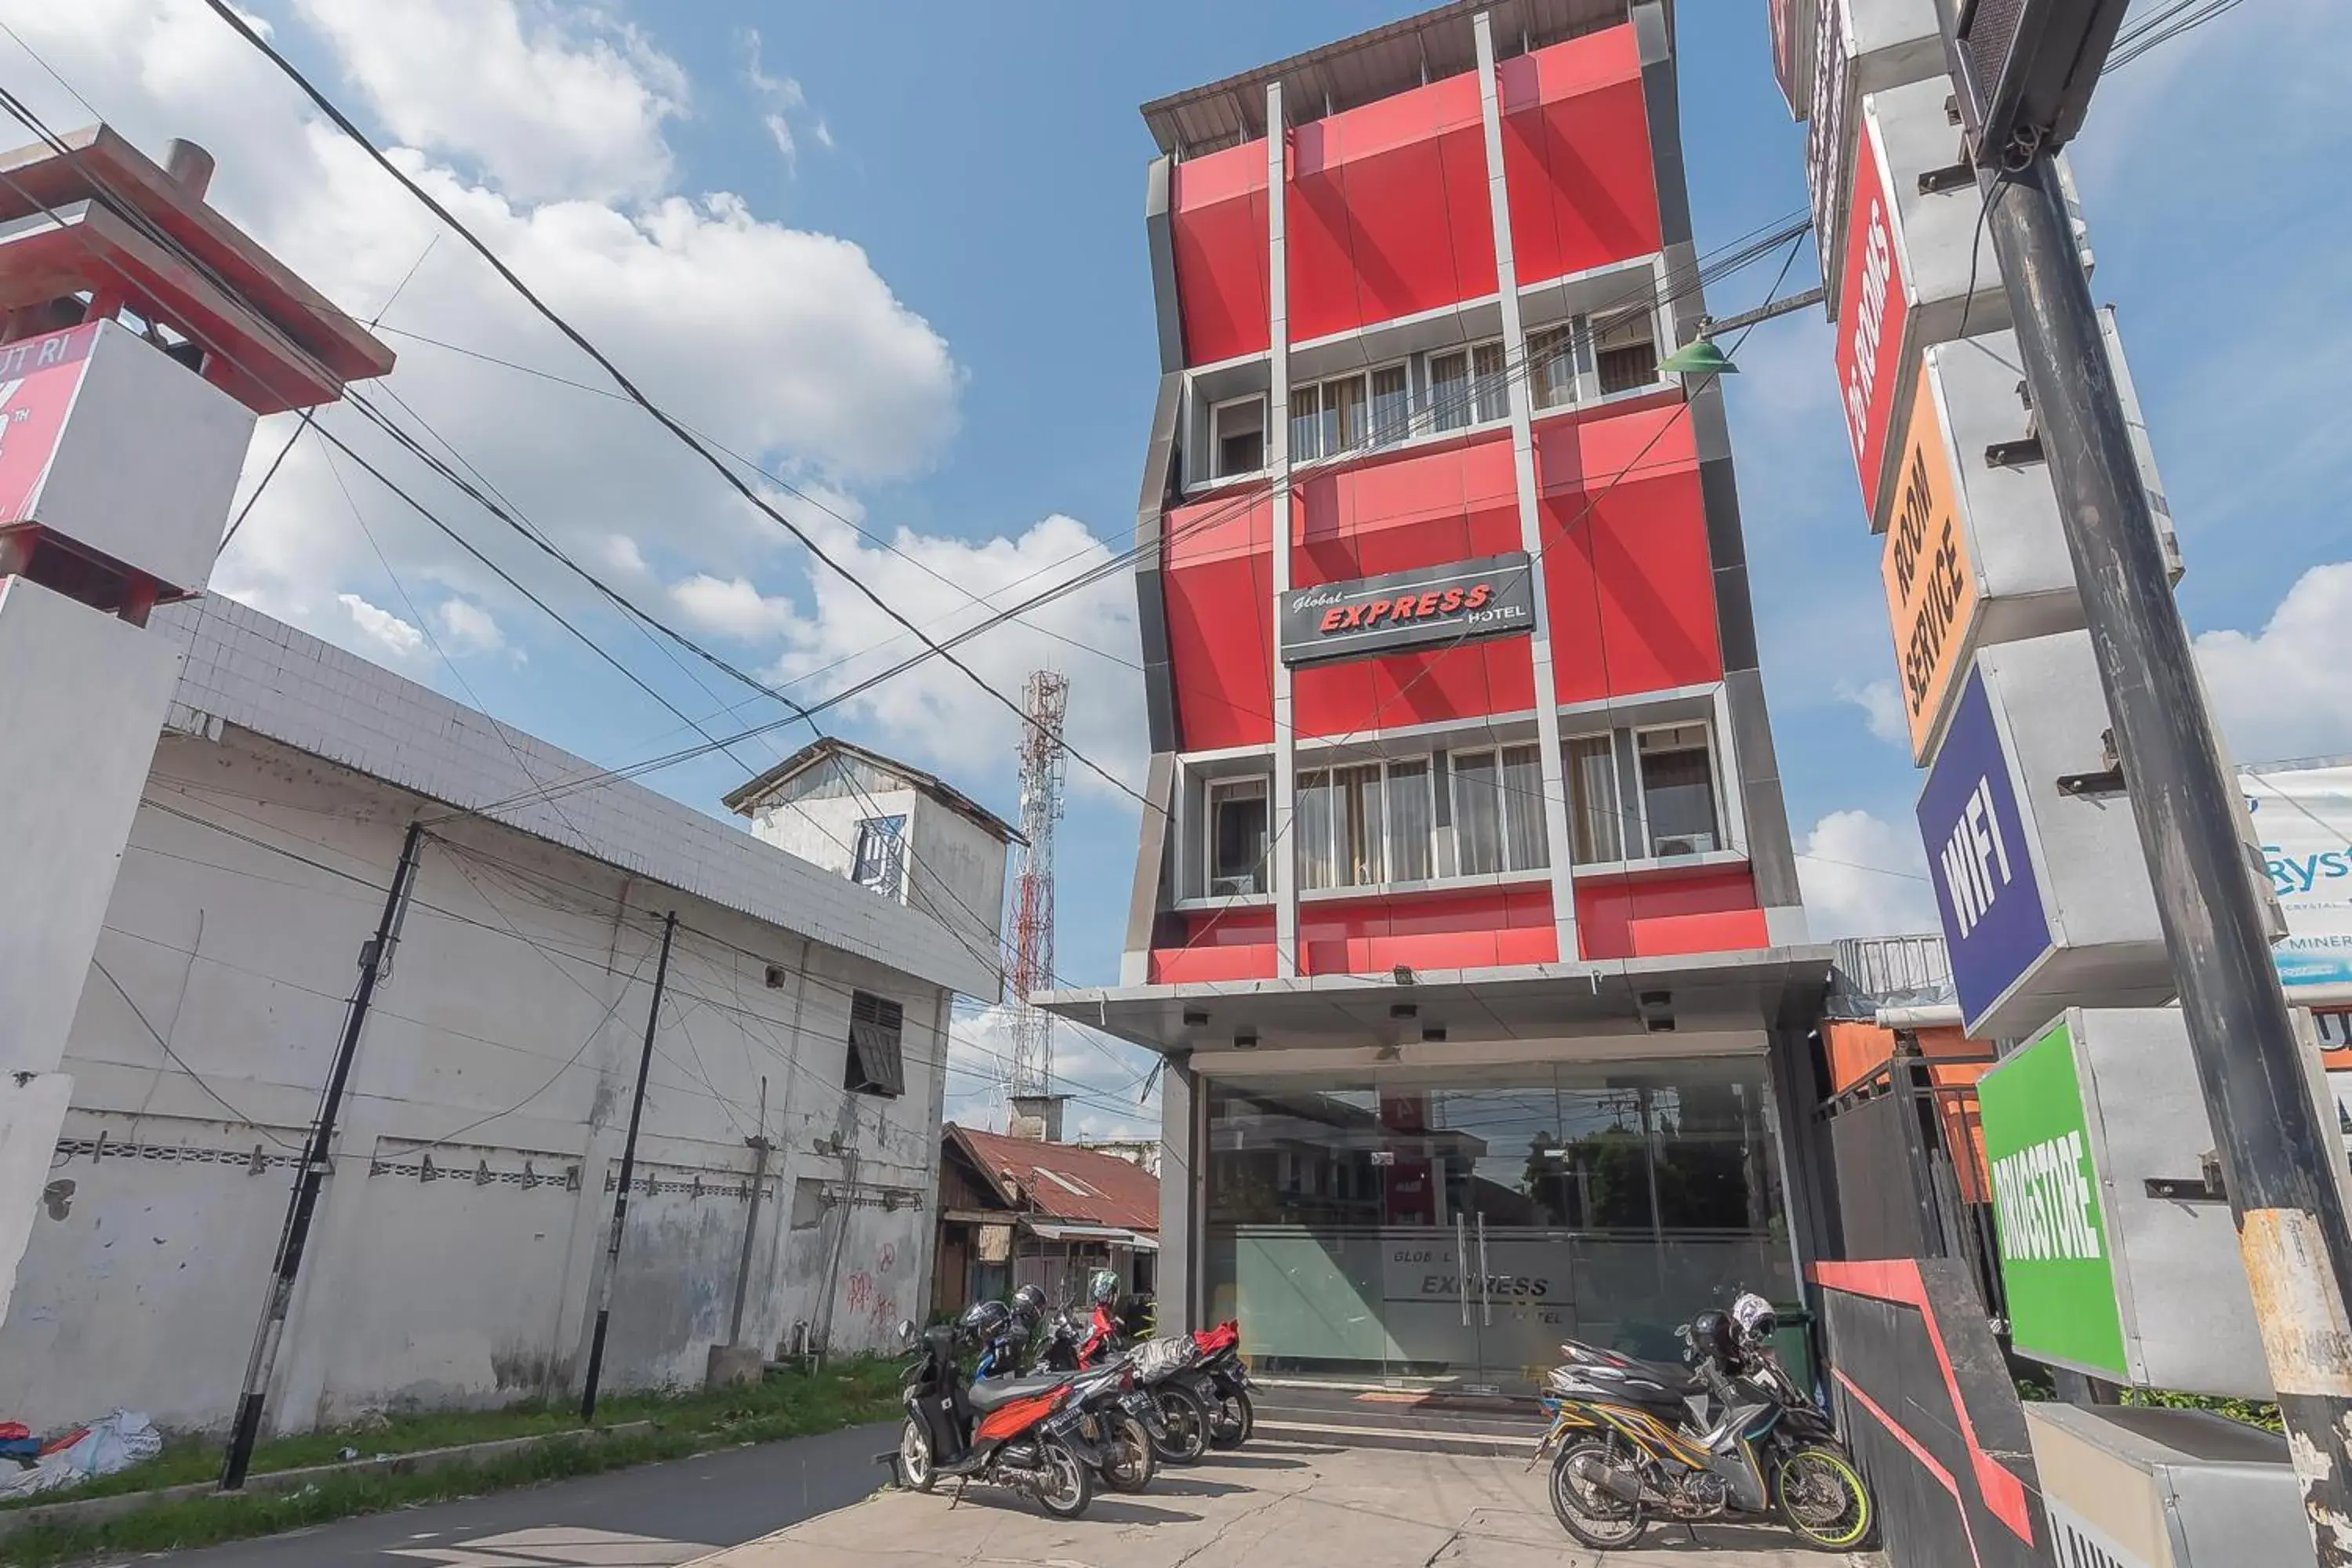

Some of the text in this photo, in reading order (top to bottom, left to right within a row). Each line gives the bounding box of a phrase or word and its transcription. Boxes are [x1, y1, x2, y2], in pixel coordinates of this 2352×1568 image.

[1854, 198, 1890, 408] ROOMS
[38, 334, 70, 366] RI
[1894, 441, 1933, 608] ROOM
[1293, 591, 1343, 614] Global
[1318, 584, 1493, 633] EXPRESS
[1468, 606, 1526, 625] HOTEL
[1906, 514, 1963, 717] SERVICE
[1940, 775, 2013, 940] WIFI
[1992, 1130, 2100, 1261] DRUGSTORE
[1393, 1251, 1454, 1263] GLOBL
